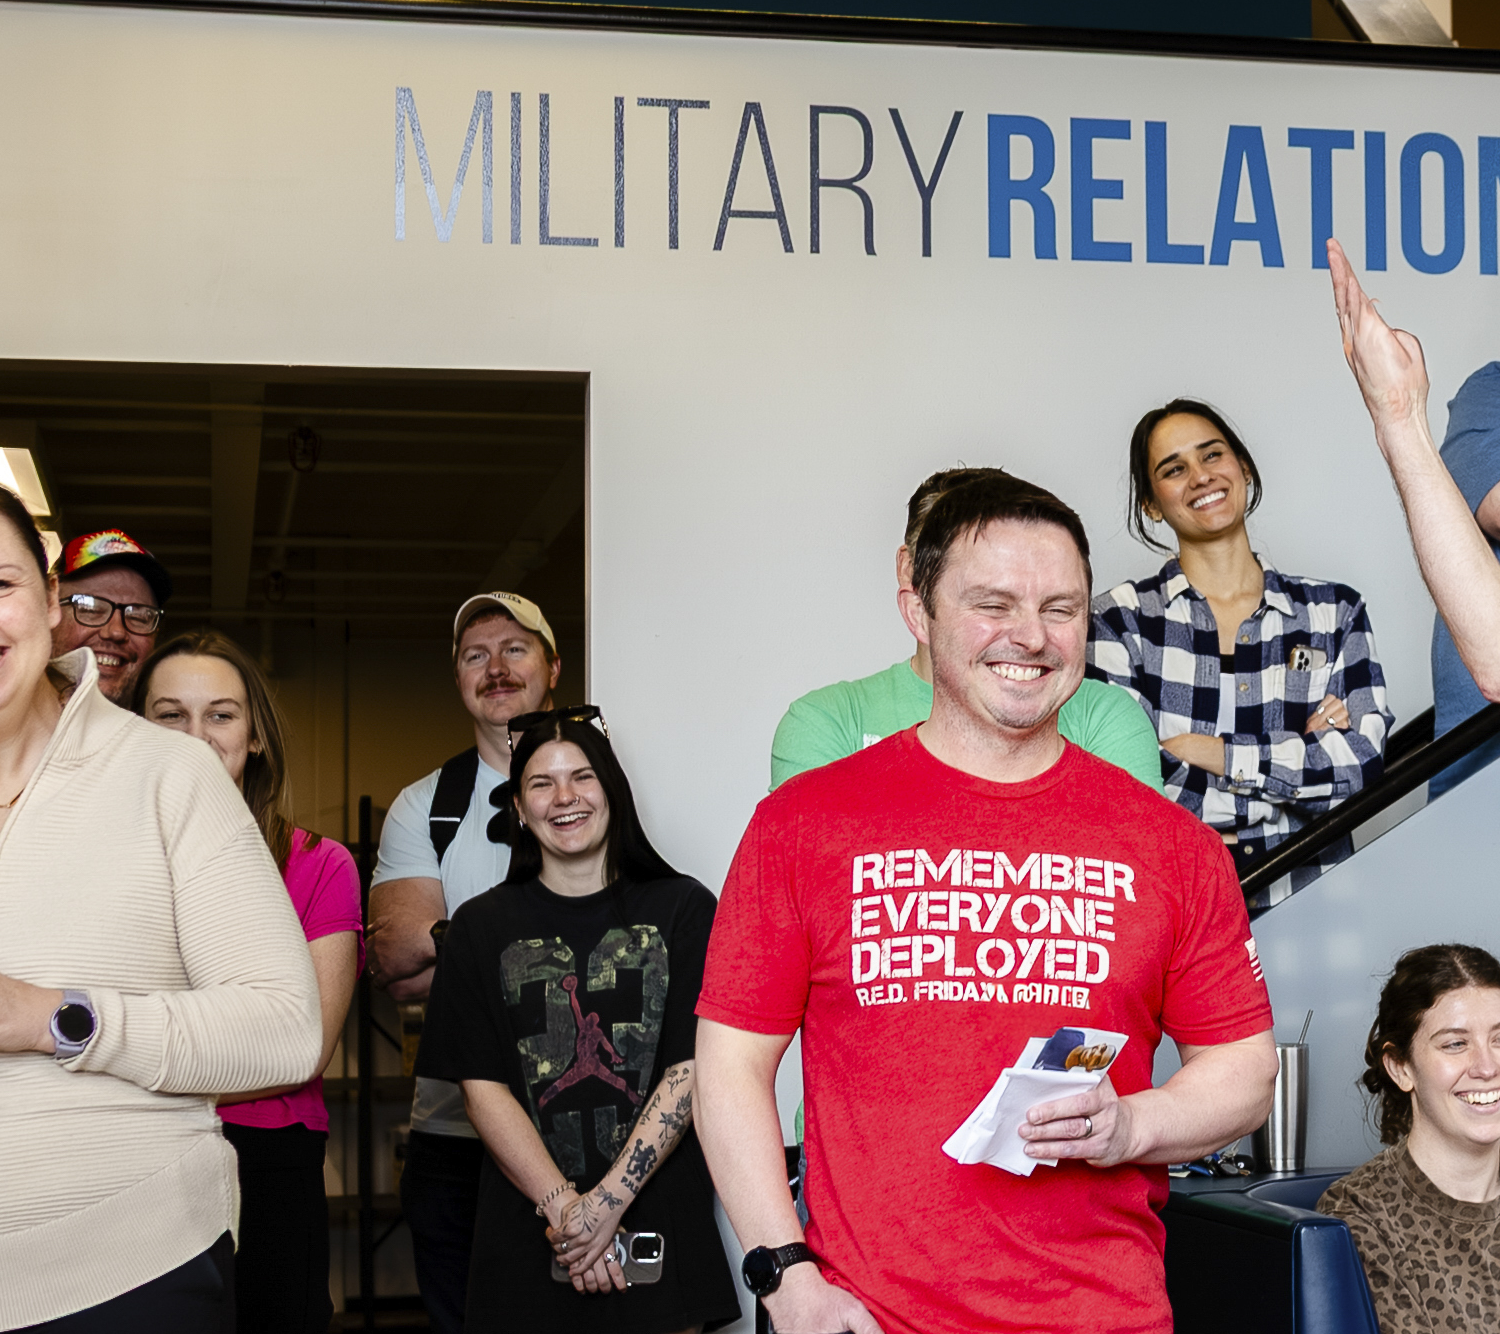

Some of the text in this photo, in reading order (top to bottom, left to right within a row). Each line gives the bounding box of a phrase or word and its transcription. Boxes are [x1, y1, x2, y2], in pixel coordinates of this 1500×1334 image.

[393, 85, 965, 259] MILITARY
[851, 848, 1137, 903] REMEMBER
[850, 890, 1117, 942] EVERYONE
[850, 935, 1111, 985] DEPLOYED
[855, 982, 909, 1008] R.E.D.
